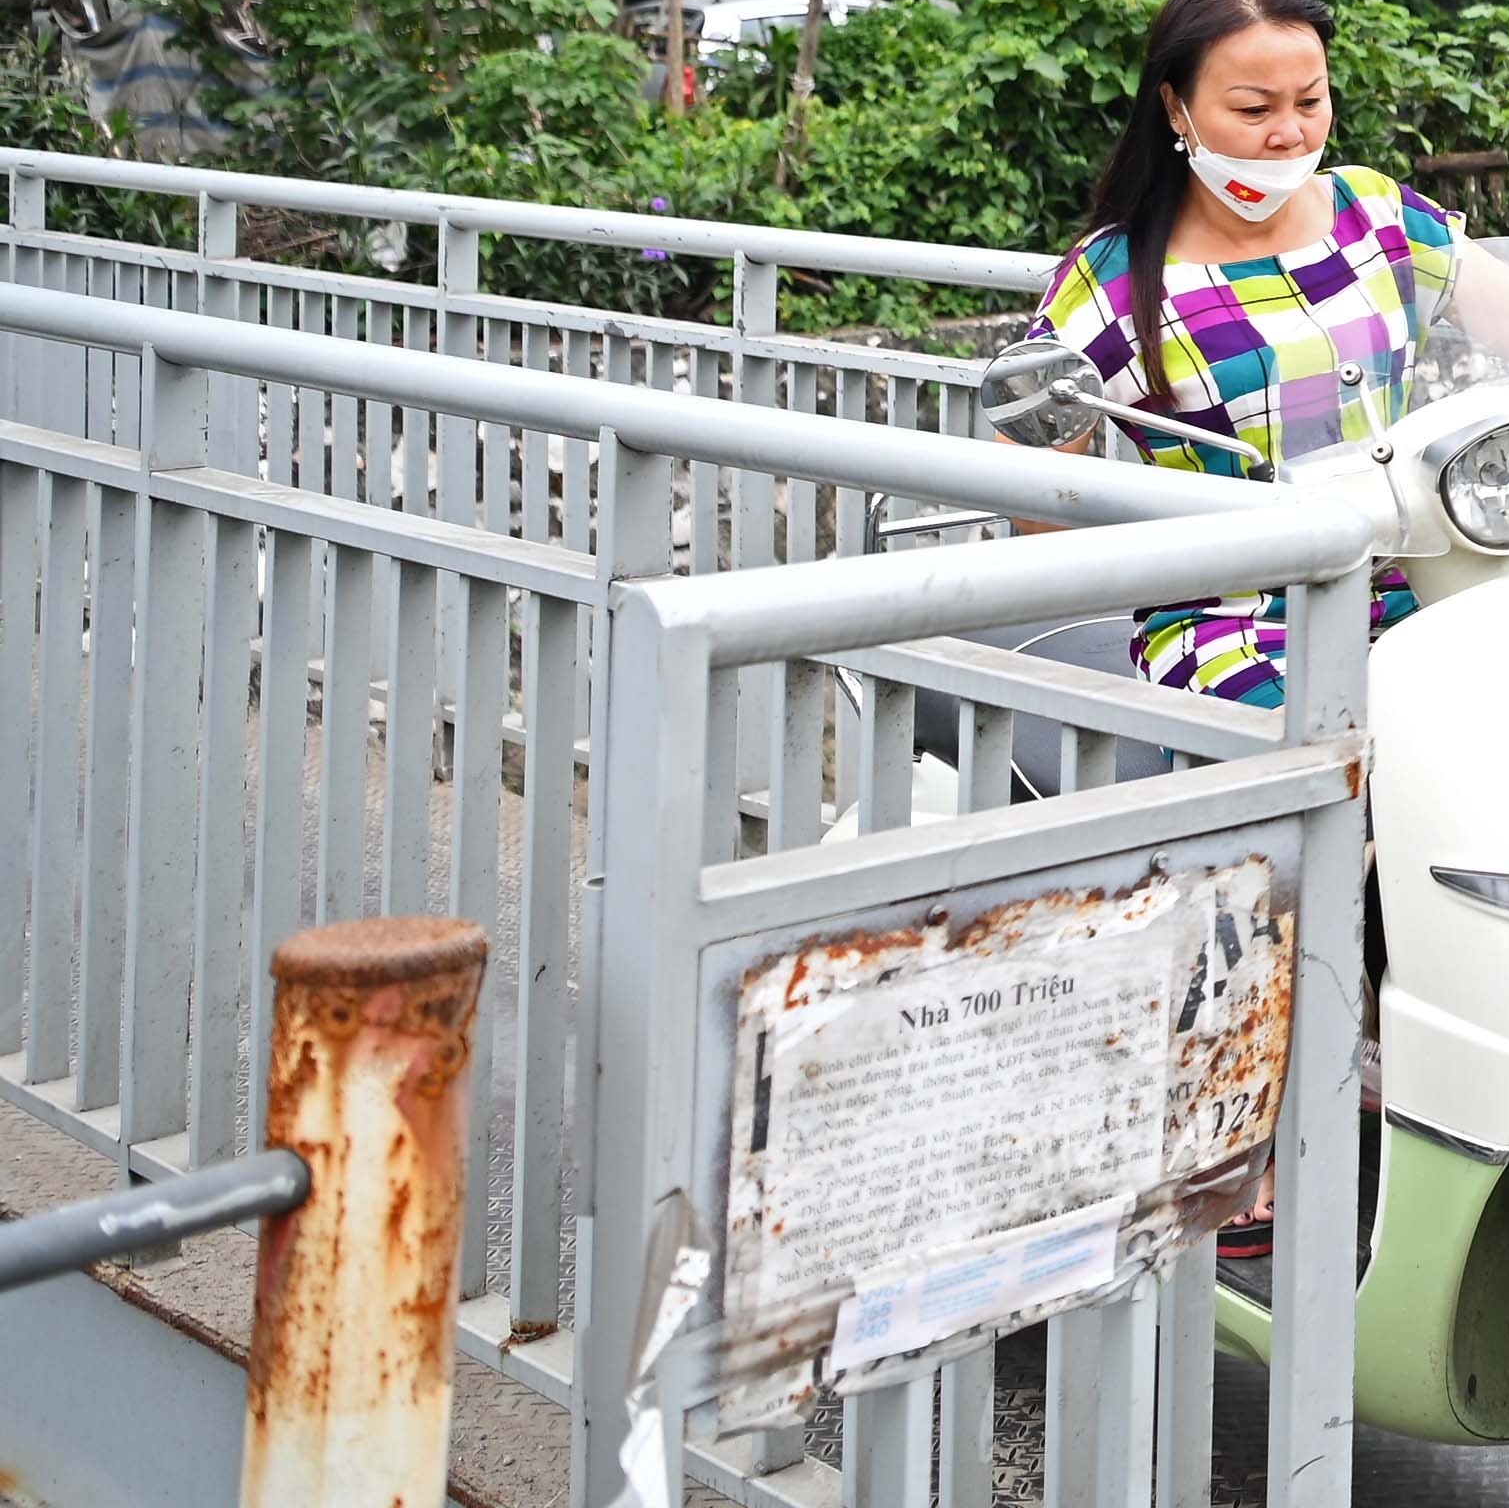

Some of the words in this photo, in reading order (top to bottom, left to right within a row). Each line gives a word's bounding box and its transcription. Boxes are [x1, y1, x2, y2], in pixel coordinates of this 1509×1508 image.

[898, 1001, 949, 1034] Nhà
[960, 989, 1002, 1019] 700
[1010, 974, 1074, 1005] Triệu
